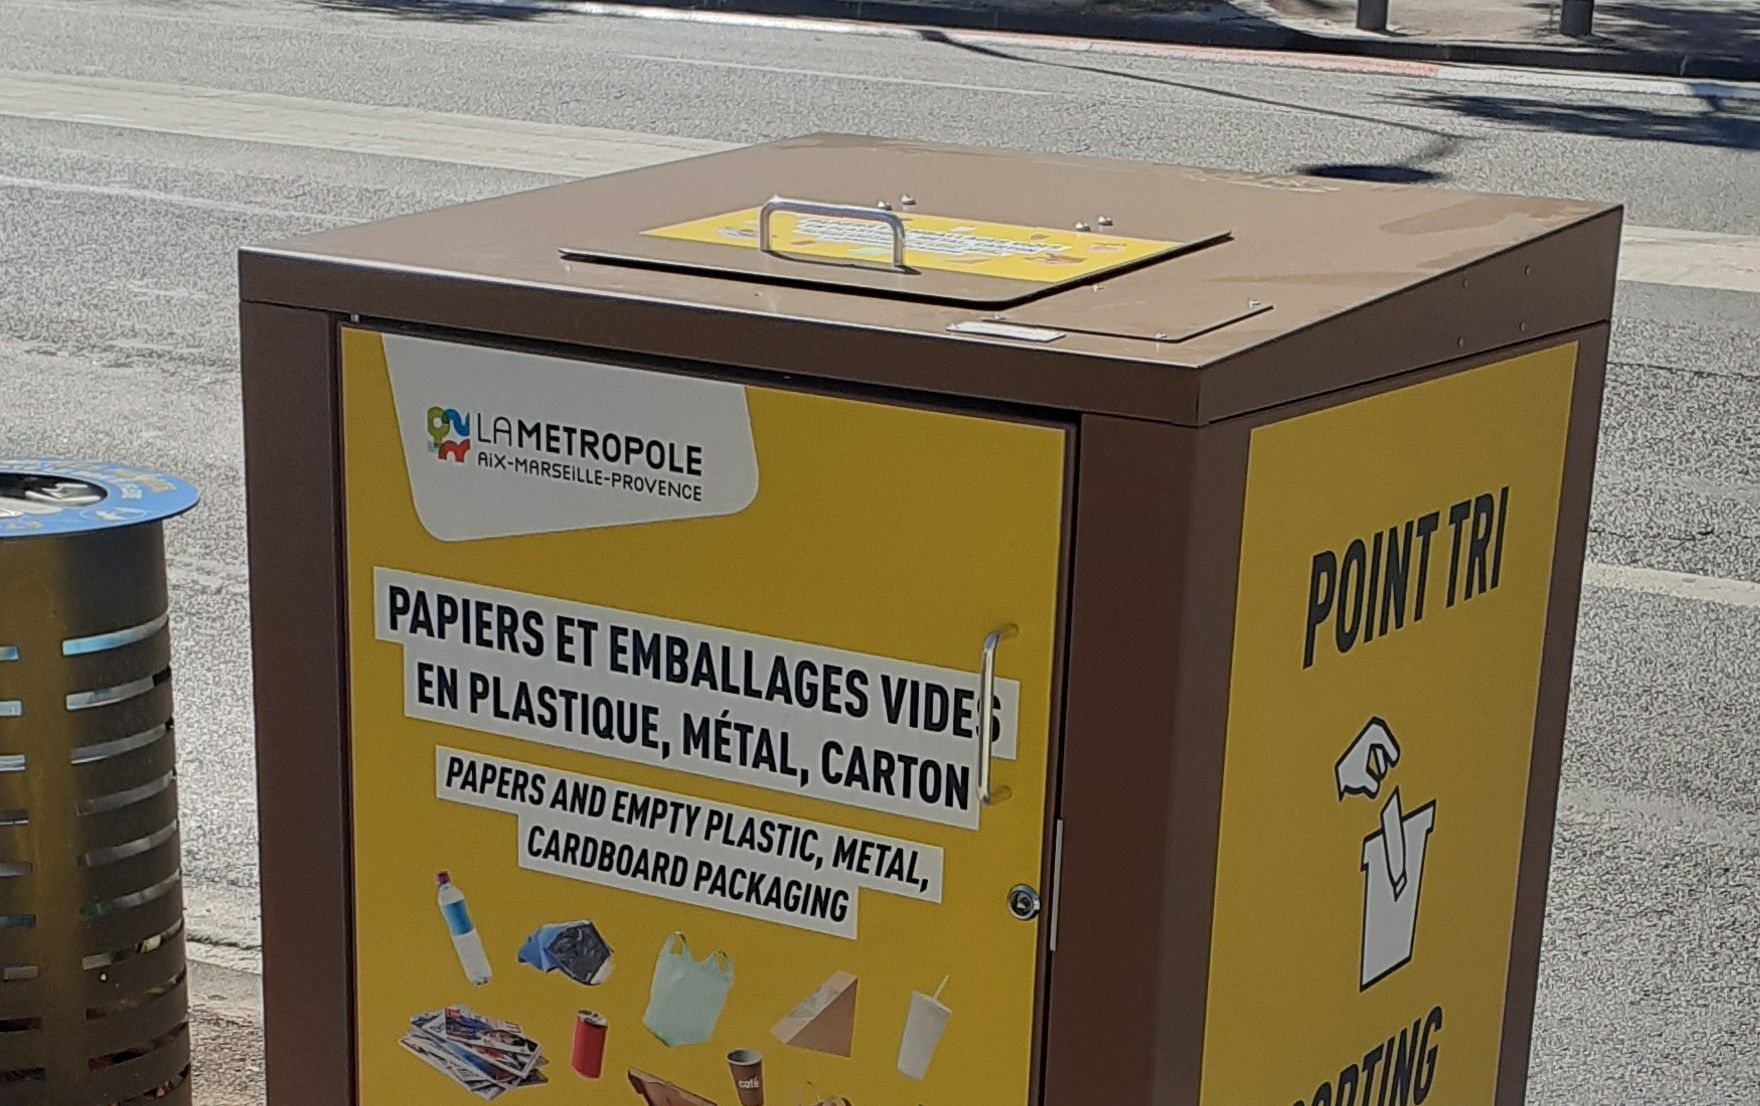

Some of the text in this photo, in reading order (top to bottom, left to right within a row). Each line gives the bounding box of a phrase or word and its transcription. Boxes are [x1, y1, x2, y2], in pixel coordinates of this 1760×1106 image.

[1303, 486, 1509, 669] POINT TRI
[388, 585, 544, 657] PAPIERS
[556, 615, 598, 667] ET
[609, 625, 869, 718] EMBALLAGES
[417, 661, 969, 810] EN PLASTIQUE, MÉTAL, CARTON
[446, 756, 929, 893] PAPERS AND EMPTY PLASTIC, METAL,
[528, 825, 849, 922] CARDBOARD PACKAGING
